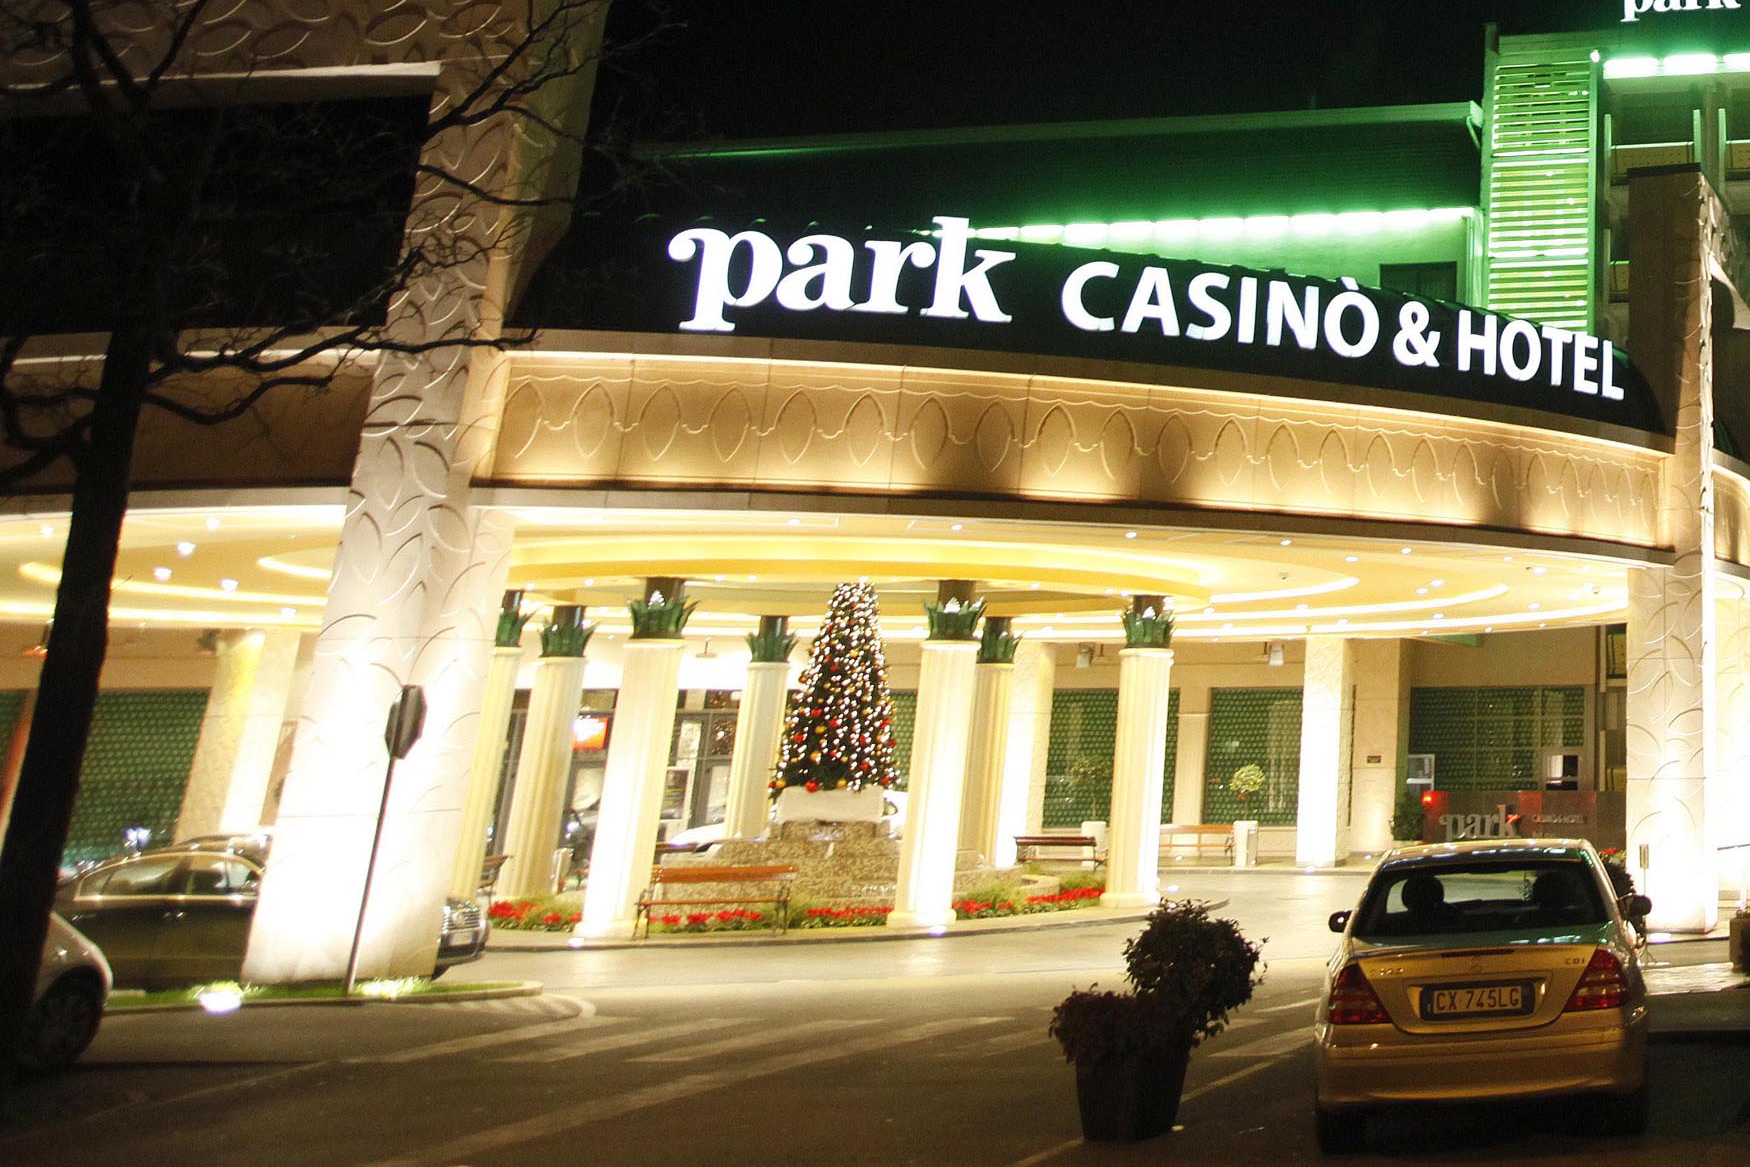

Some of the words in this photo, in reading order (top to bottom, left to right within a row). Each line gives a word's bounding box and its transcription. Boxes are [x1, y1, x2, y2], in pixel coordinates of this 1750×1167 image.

[668, 215, 1017, 332] park
[1061, 261, 1380, 358] CASINÒ
[1396, 300, 1441, 368] &
[1457, 309, 1625, 401] HOTEL
[1438, 803, 1522, 839] park
[1436, 991, 1458, 1011] CX
[1465, 988, 1521, 1009] 745LG
